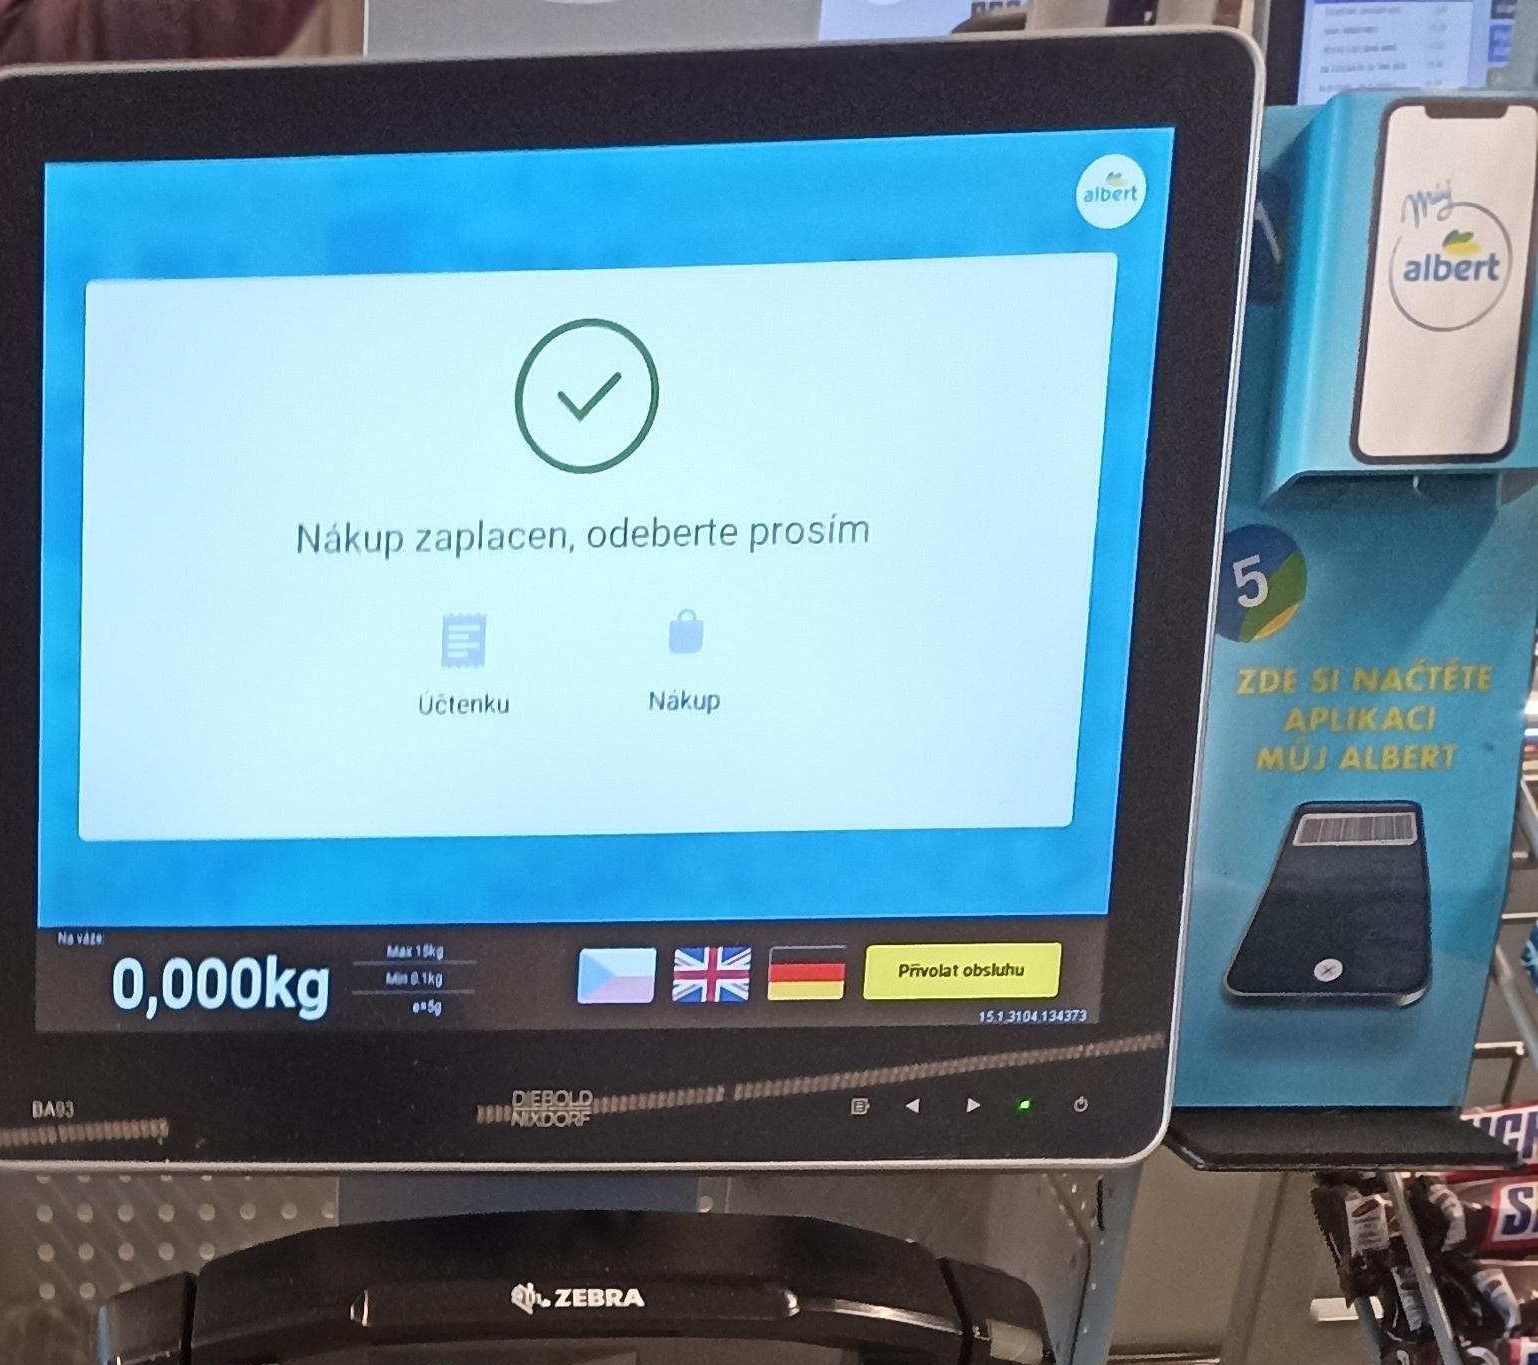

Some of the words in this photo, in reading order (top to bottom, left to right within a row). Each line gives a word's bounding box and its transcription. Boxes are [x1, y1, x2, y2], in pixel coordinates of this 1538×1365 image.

[1084, 185, 1138, 203] albert
[1403, 252, 1501, 283] albert
[296, 520, 405, 560] Nákup
[414, 519, 576, 560] zaplacen,
[586, 516, 738, 550] odeberte
[749, 513, 870, 553] prosím
[1232, 554, 1269, 608] 5
[1236, 667, 1298, 696] ZDE
[1311, 666, 1341, 694] SI
[1351, 656, 1494, 694] NAČTĚTE
[418, 688, 510, 717] Účtenku
[648, 689, 722, 716] Nákup
[1283, 703, 1437, 733] APLIKACI
[1255, 733, 1327, 772] MŮJ
[1338, 743, 1459, 772] ALBERT
[386, 944, 413, 958] Max
[385, 971, 409, 985] Min
[962, 962, 1026, 977] obsluhu
[112, 954, 330, 1021] 0,000kg
[512, 1089, 594, 1108] DIEBOLD
[511, 1110, 592, 1128] NIXDORF
[554, 1287, 646, 1308] ZEBRA
